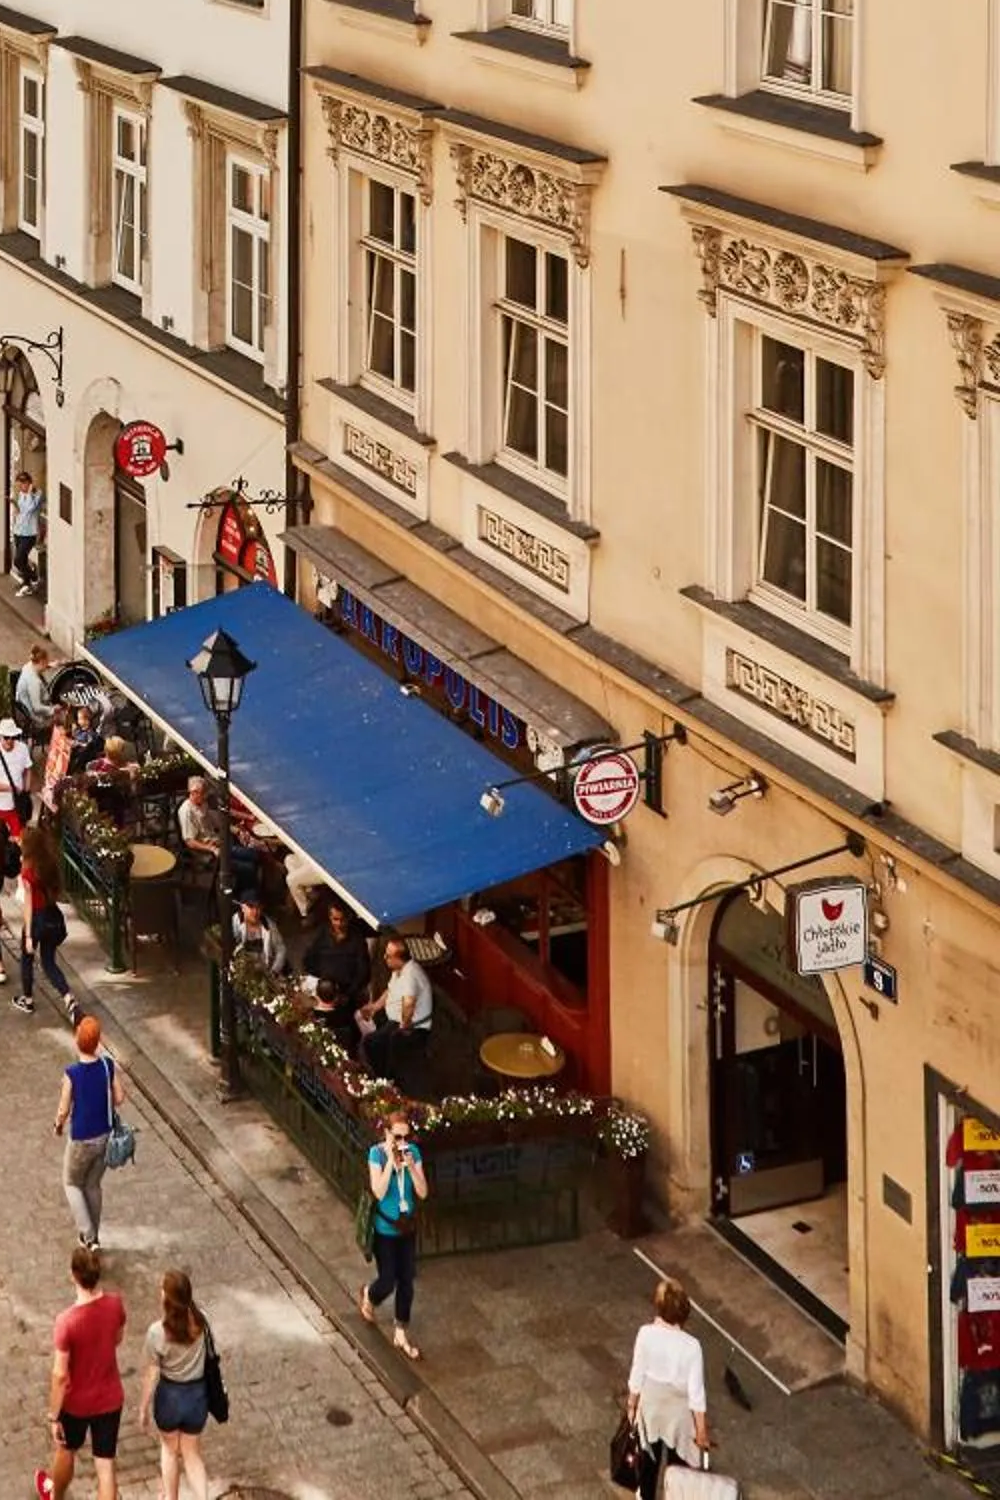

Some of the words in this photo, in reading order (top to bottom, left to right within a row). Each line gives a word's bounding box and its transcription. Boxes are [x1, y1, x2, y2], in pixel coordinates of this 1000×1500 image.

[342, 588, 519, 749] AKROPOLIS
[578, 776, 635, 796] PIWIARNIA
[873, 970, 884, 991] 9
